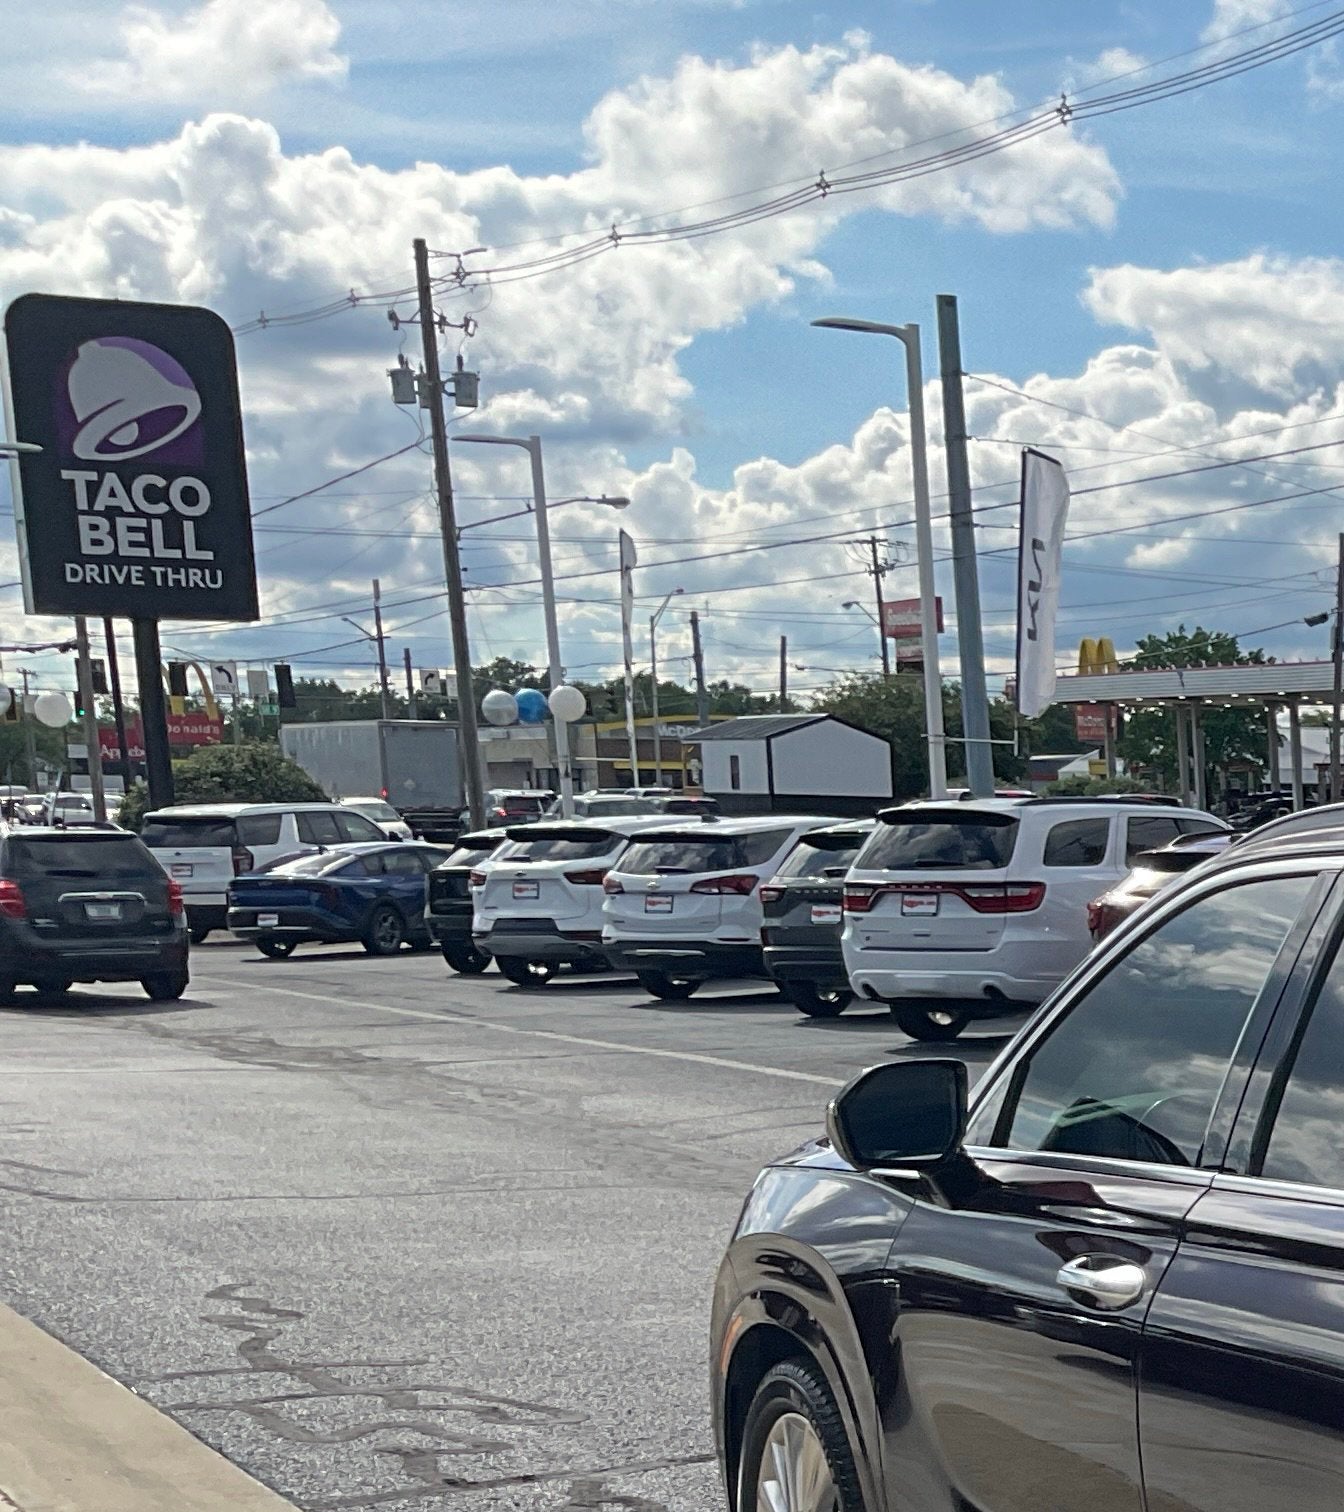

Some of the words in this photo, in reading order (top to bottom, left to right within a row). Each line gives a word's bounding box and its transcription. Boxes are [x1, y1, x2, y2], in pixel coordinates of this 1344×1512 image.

[61, 469, 212, 517] TACO
[78, 515, 214, 560] BELL
[64, 563, 145, 586] DRIVE
[150, 566, 223, 589] THRU
